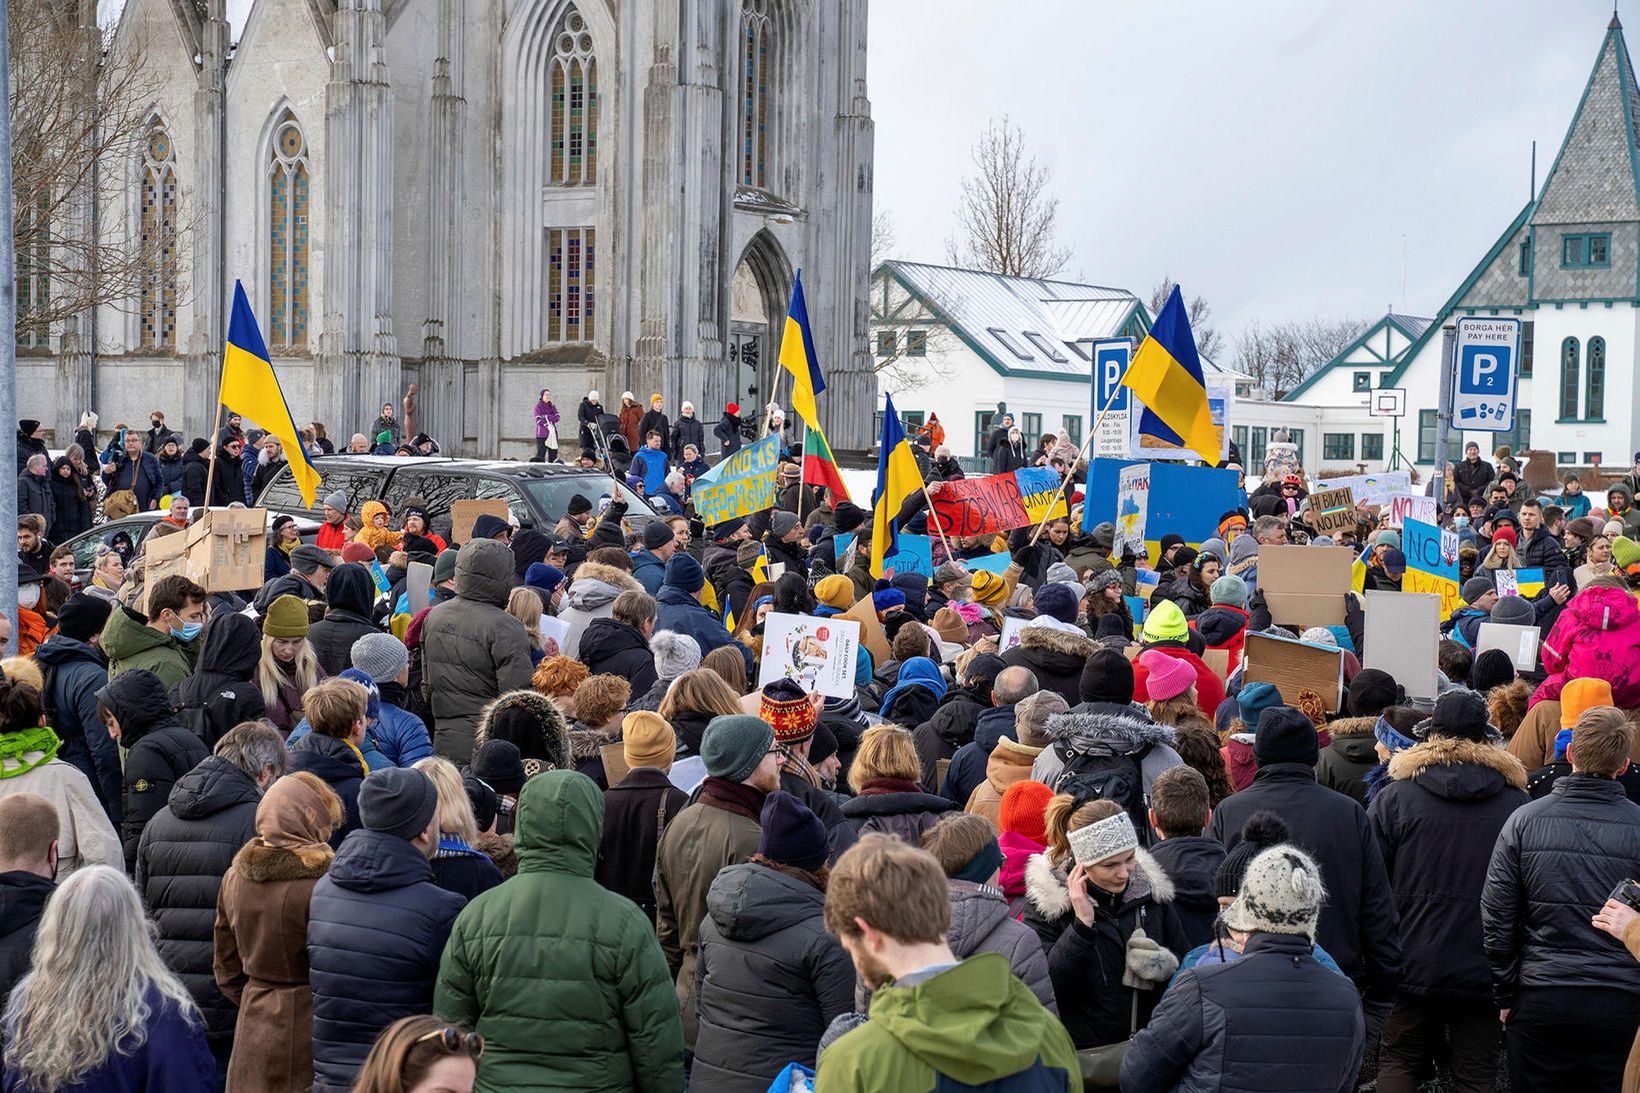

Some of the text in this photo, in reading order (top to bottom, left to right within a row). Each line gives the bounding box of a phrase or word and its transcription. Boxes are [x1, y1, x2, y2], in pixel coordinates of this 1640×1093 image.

[1464, 324, 1513, 332] BORGA HÉR
[1105, 361, 1120, 400] P
[1472, 353, 1498, 387] P 2
[757, 442, 775, 468] AS
[928, 480, 1026, 537] STOP WAR
[1316, 511, 1356, 532] NO WAR
[1391, 496, 1412, 524] NO
[1409, 529, 1440, 567] NO
[894, 560, 919, 573] STOP
